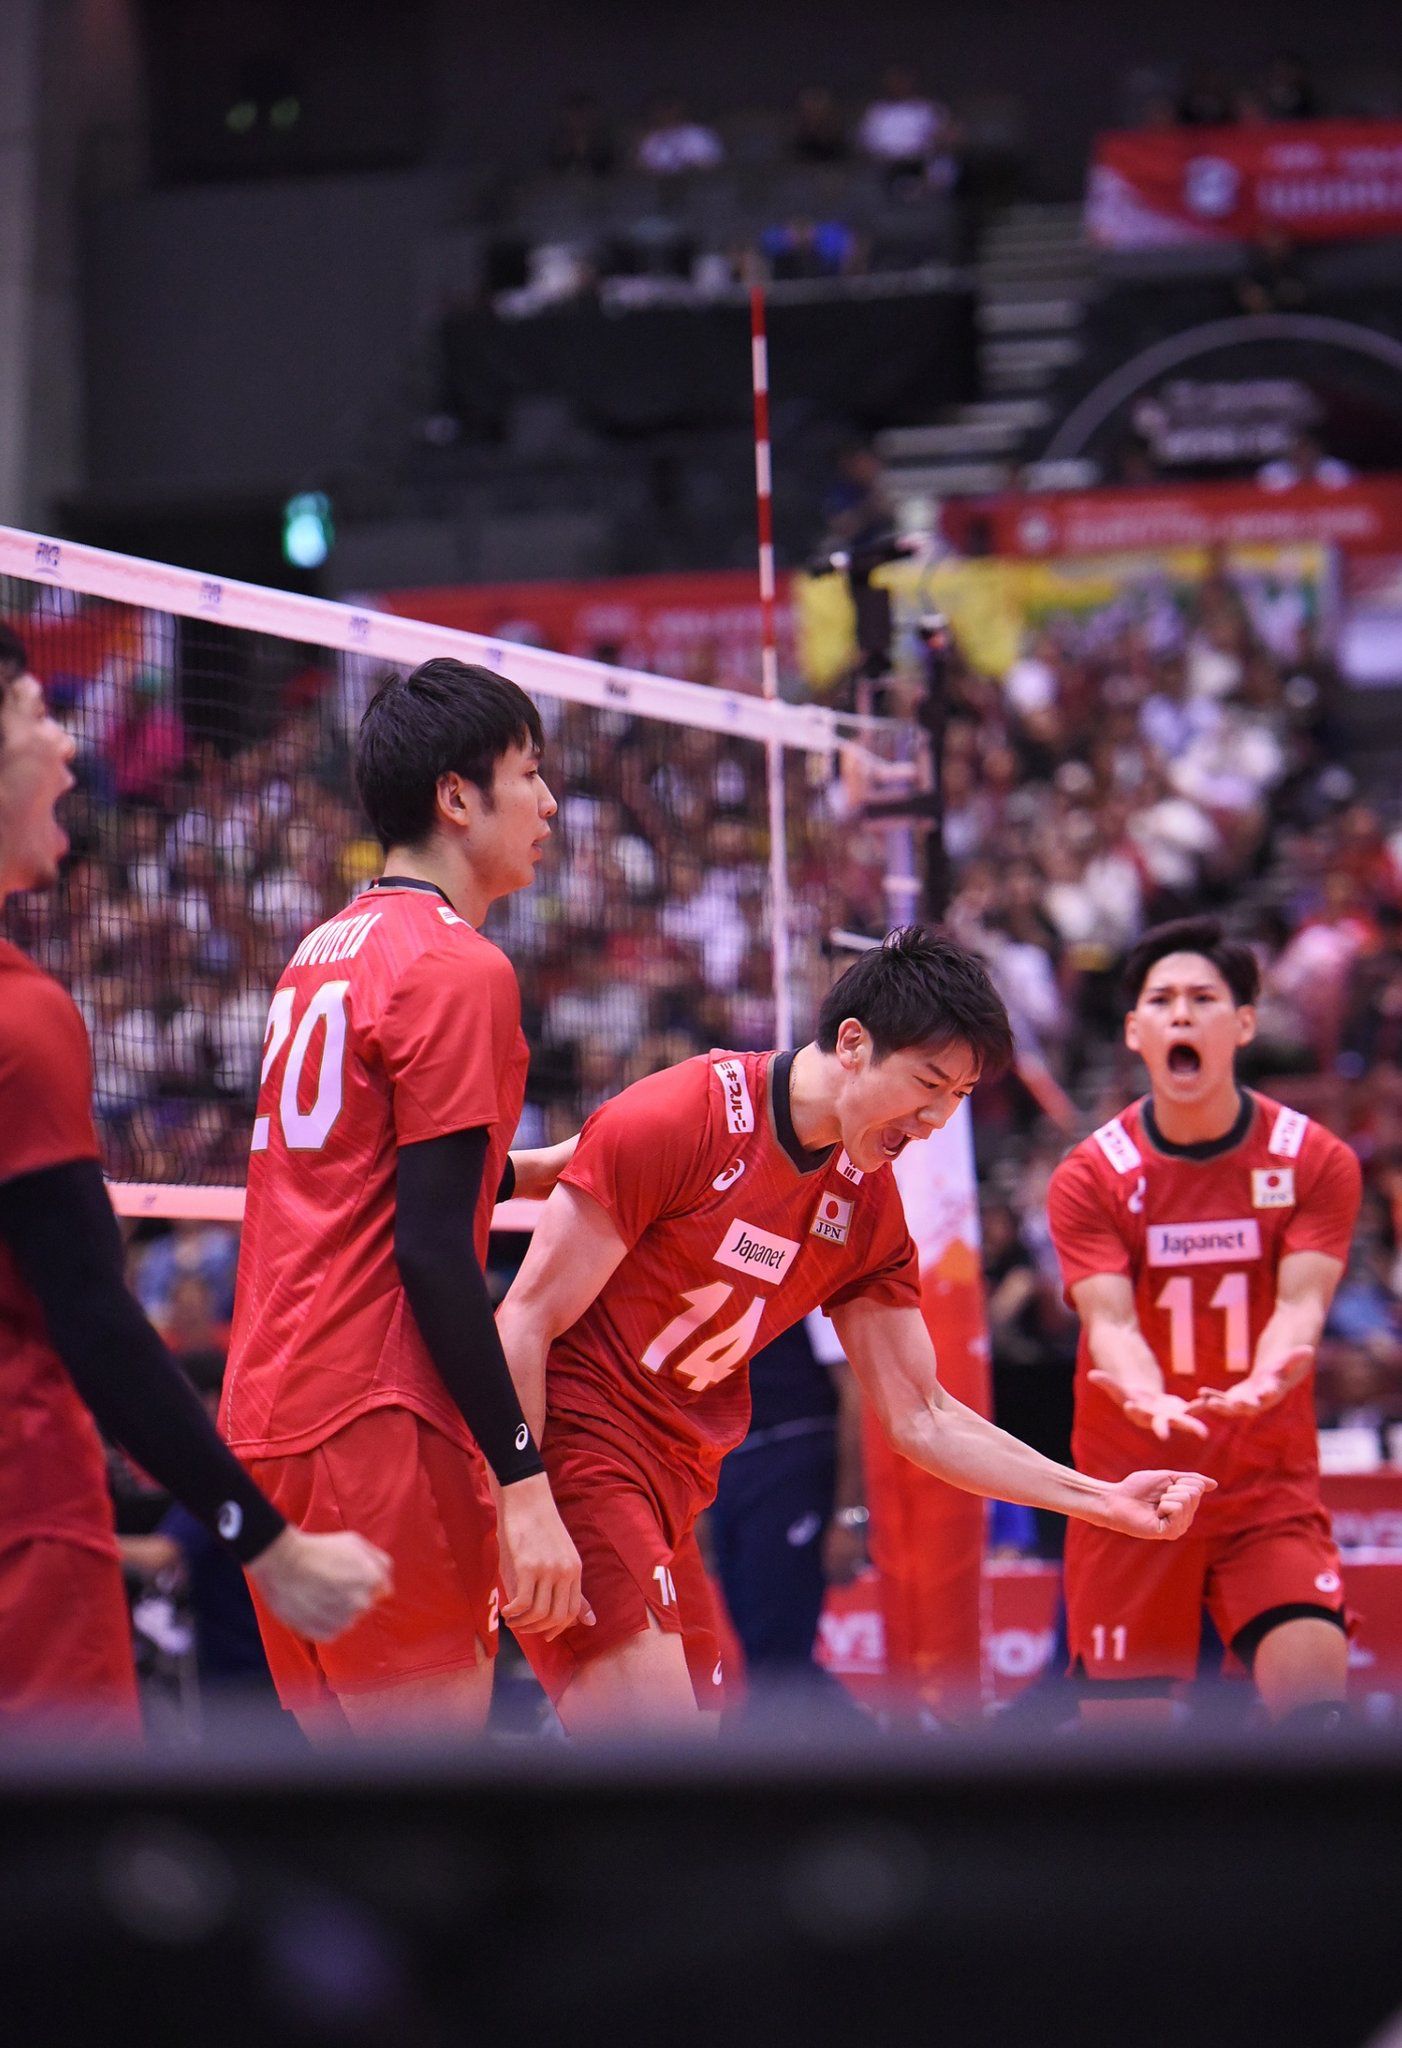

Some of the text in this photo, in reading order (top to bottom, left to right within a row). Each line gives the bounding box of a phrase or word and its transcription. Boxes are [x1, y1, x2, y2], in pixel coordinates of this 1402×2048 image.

[250, 979, 351, 1152] 20
[719, 1062, 747, 1132] ミキプルーン
[731, 1231, 787, 1270] Japanet
[815, 1221, 843, 1241] JPN
[1160, 1230, 1245, 1255] Japanet
[639, 1280, 767, 1392] 14
[1155, 1272, 1250, 1375] 11
[1091, 1625, 1128, 1662] 11
